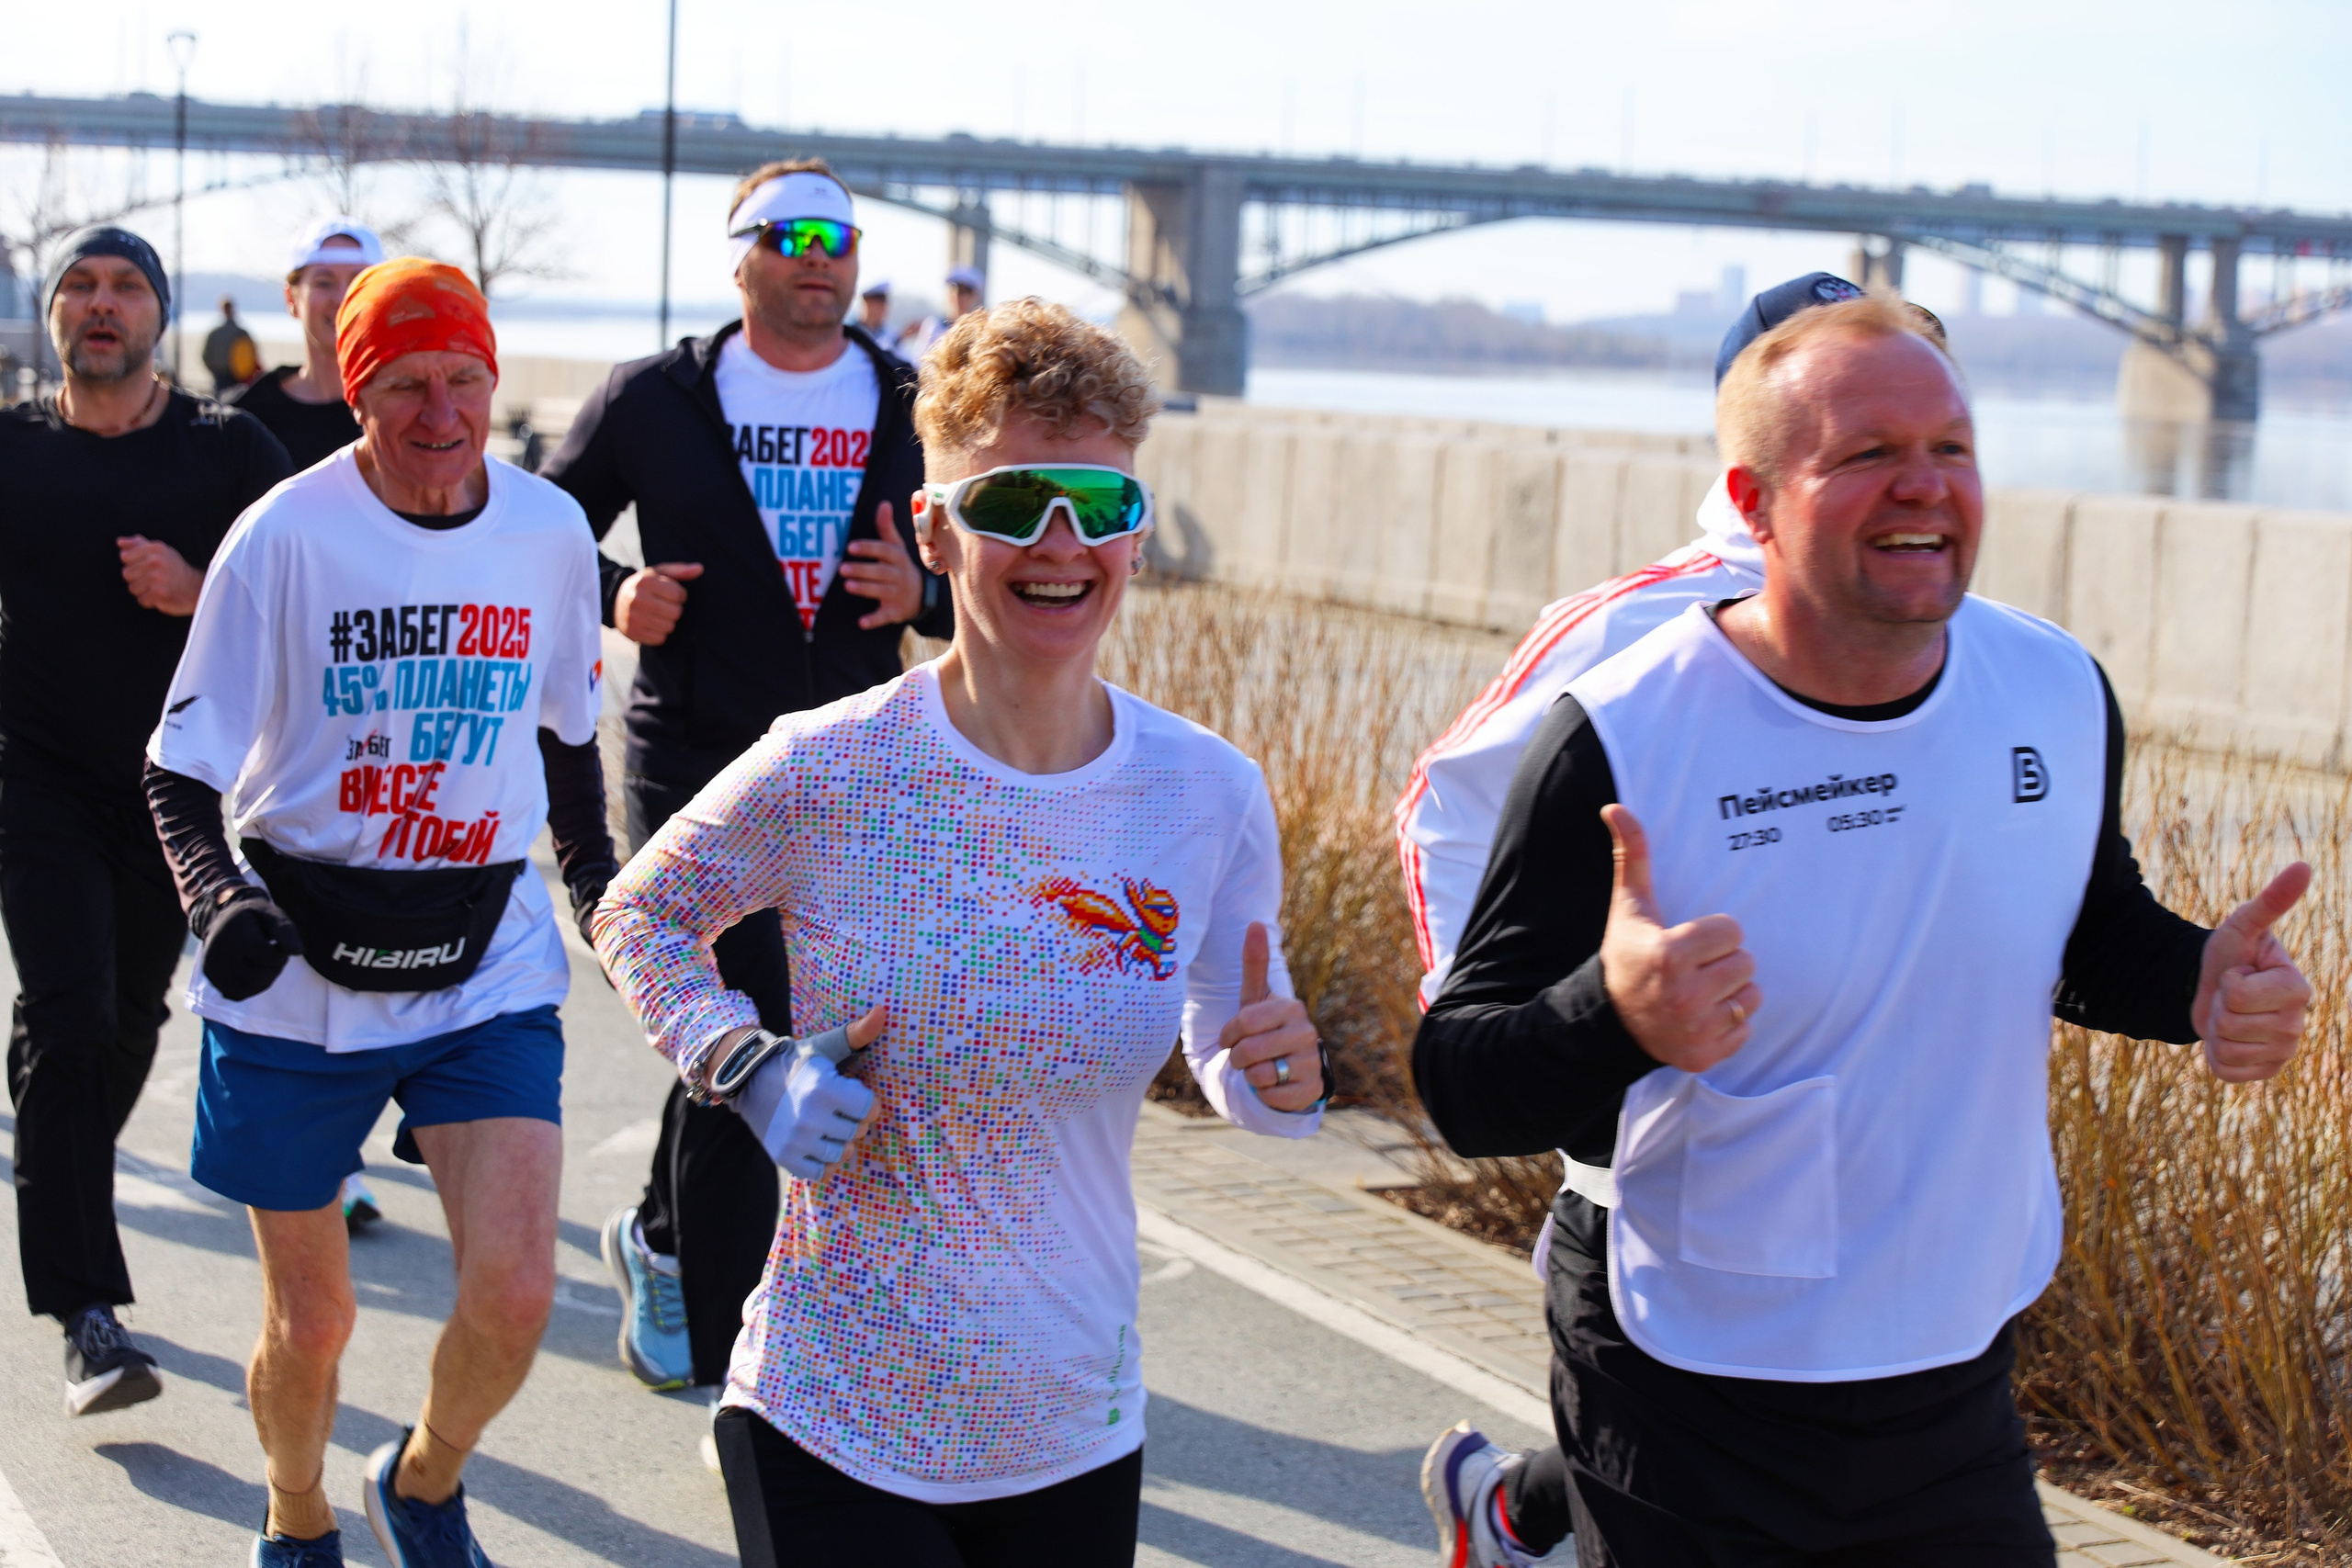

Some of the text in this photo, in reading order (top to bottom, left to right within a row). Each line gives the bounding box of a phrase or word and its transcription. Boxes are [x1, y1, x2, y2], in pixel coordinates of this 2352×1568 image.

[728, 423, 875, 469] АБЕГ202
[330, 604, 531, 663] #ЗАБЕГ2025
[323, 659, 532, 716] 45% ПЛАНЕТЫ
[410, 712, 504, 766] БЕГУТ
[1718, 773, 1898, 820] Пейсмейкер
[1726, 827, 1782, 851] 27:30
[332, 936, 467, 969] HIBIRU
